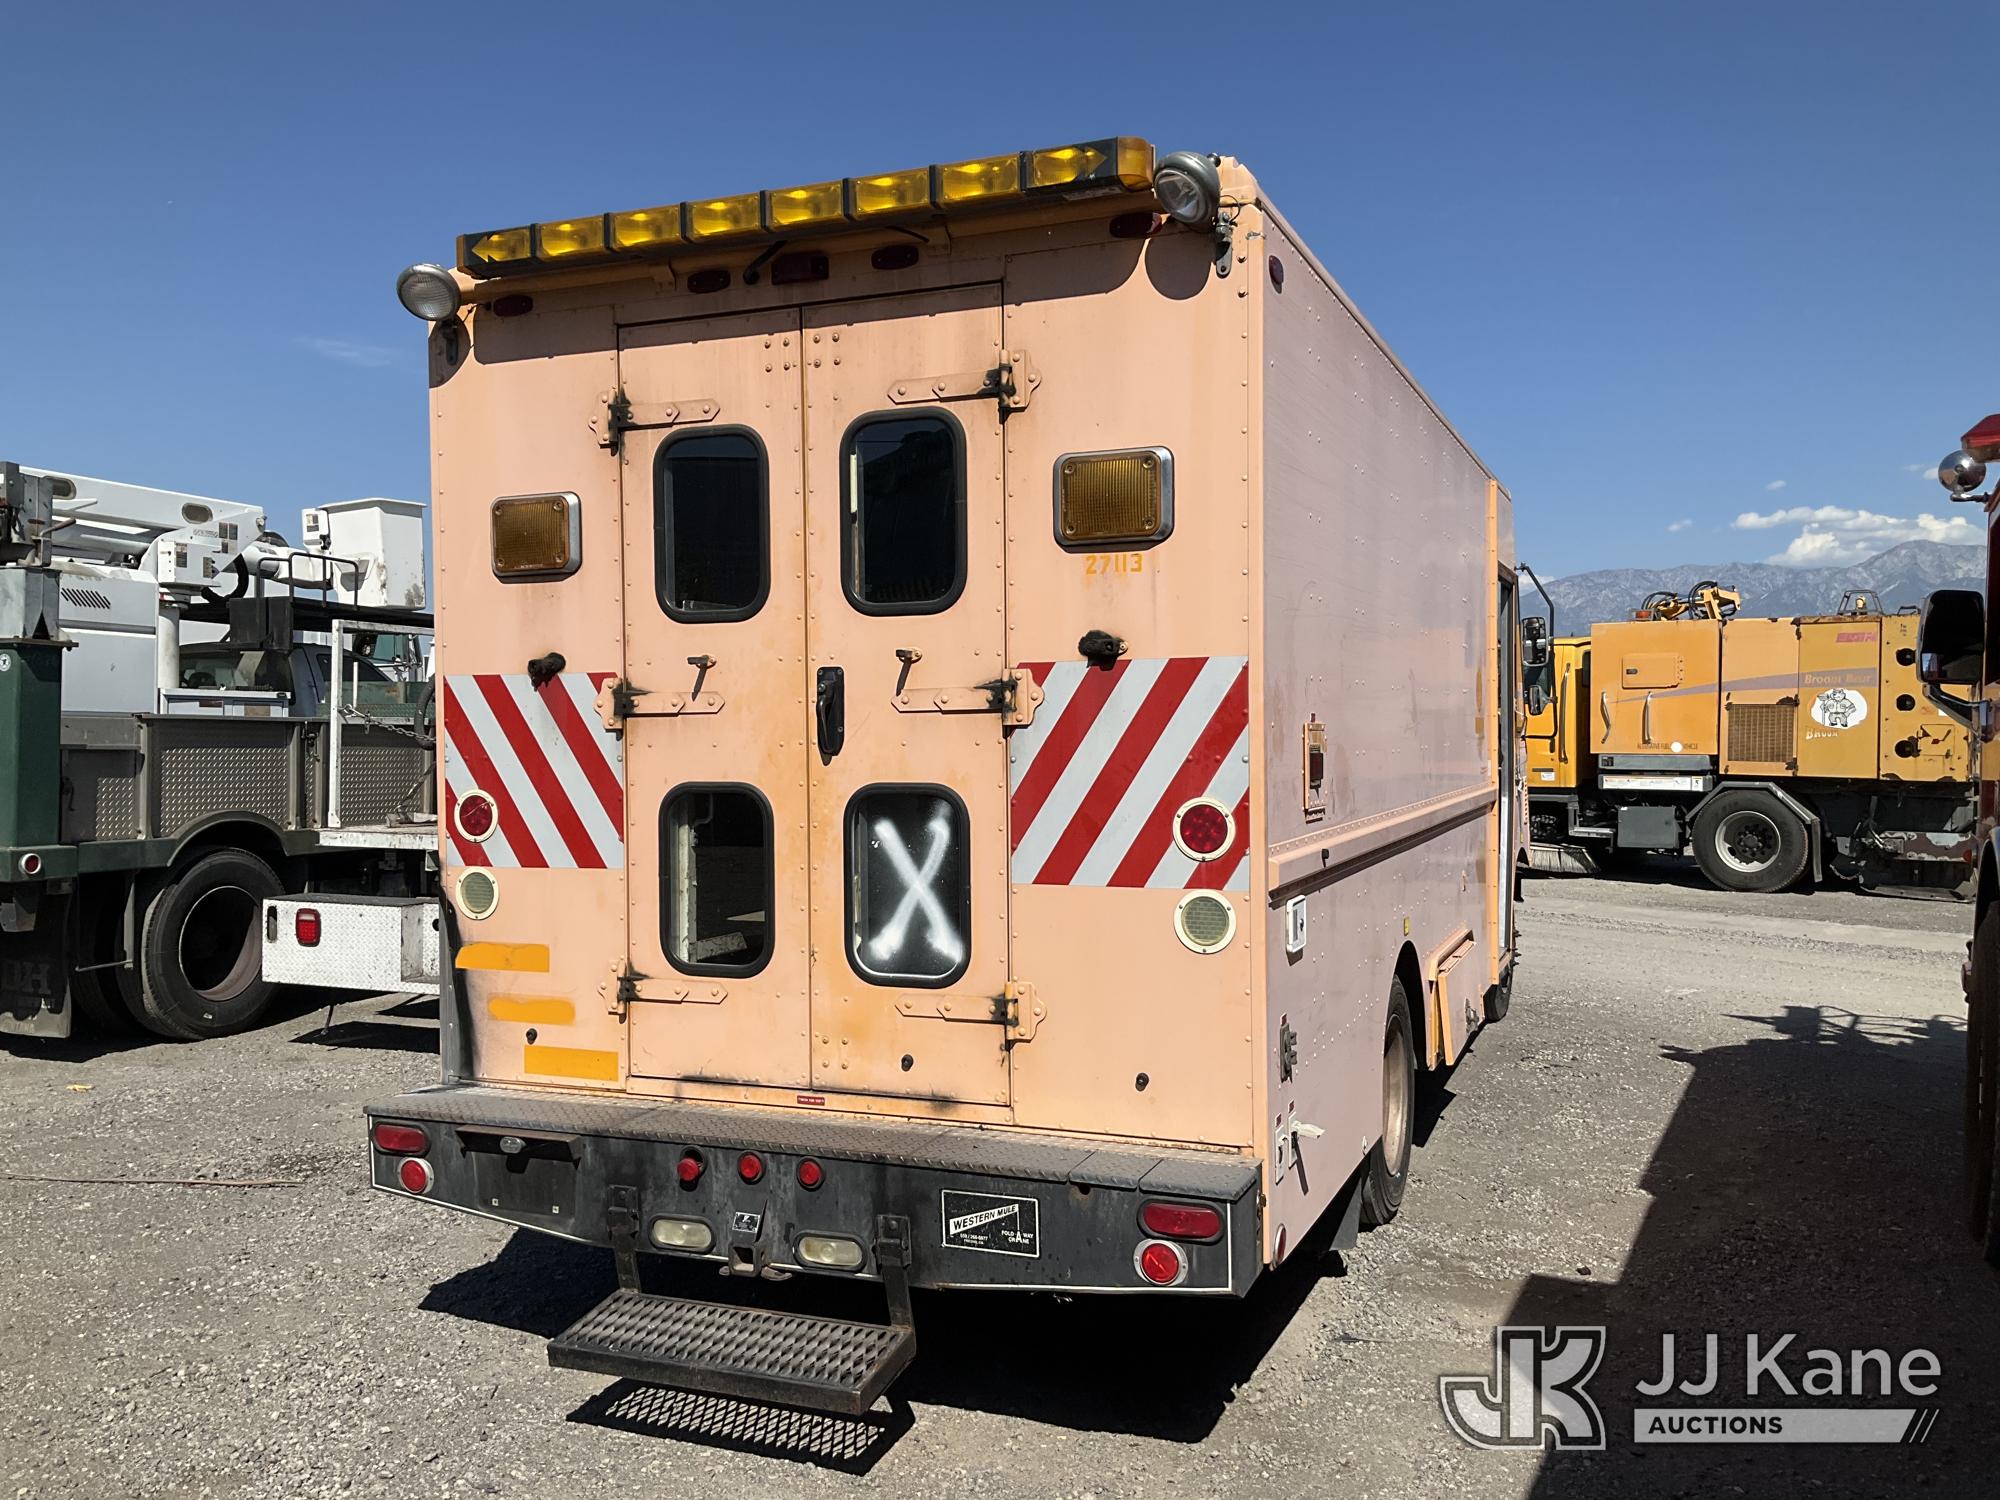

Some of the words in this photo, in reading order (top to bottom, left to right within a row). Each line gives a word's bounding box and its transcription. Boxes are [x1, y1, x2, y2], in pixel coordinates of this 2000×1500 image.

[1086, 553, 1143, 576] 27113
[953, 1211, 996, 1231] WESTERN
[997, 1205, 1017, 1217] MULE
